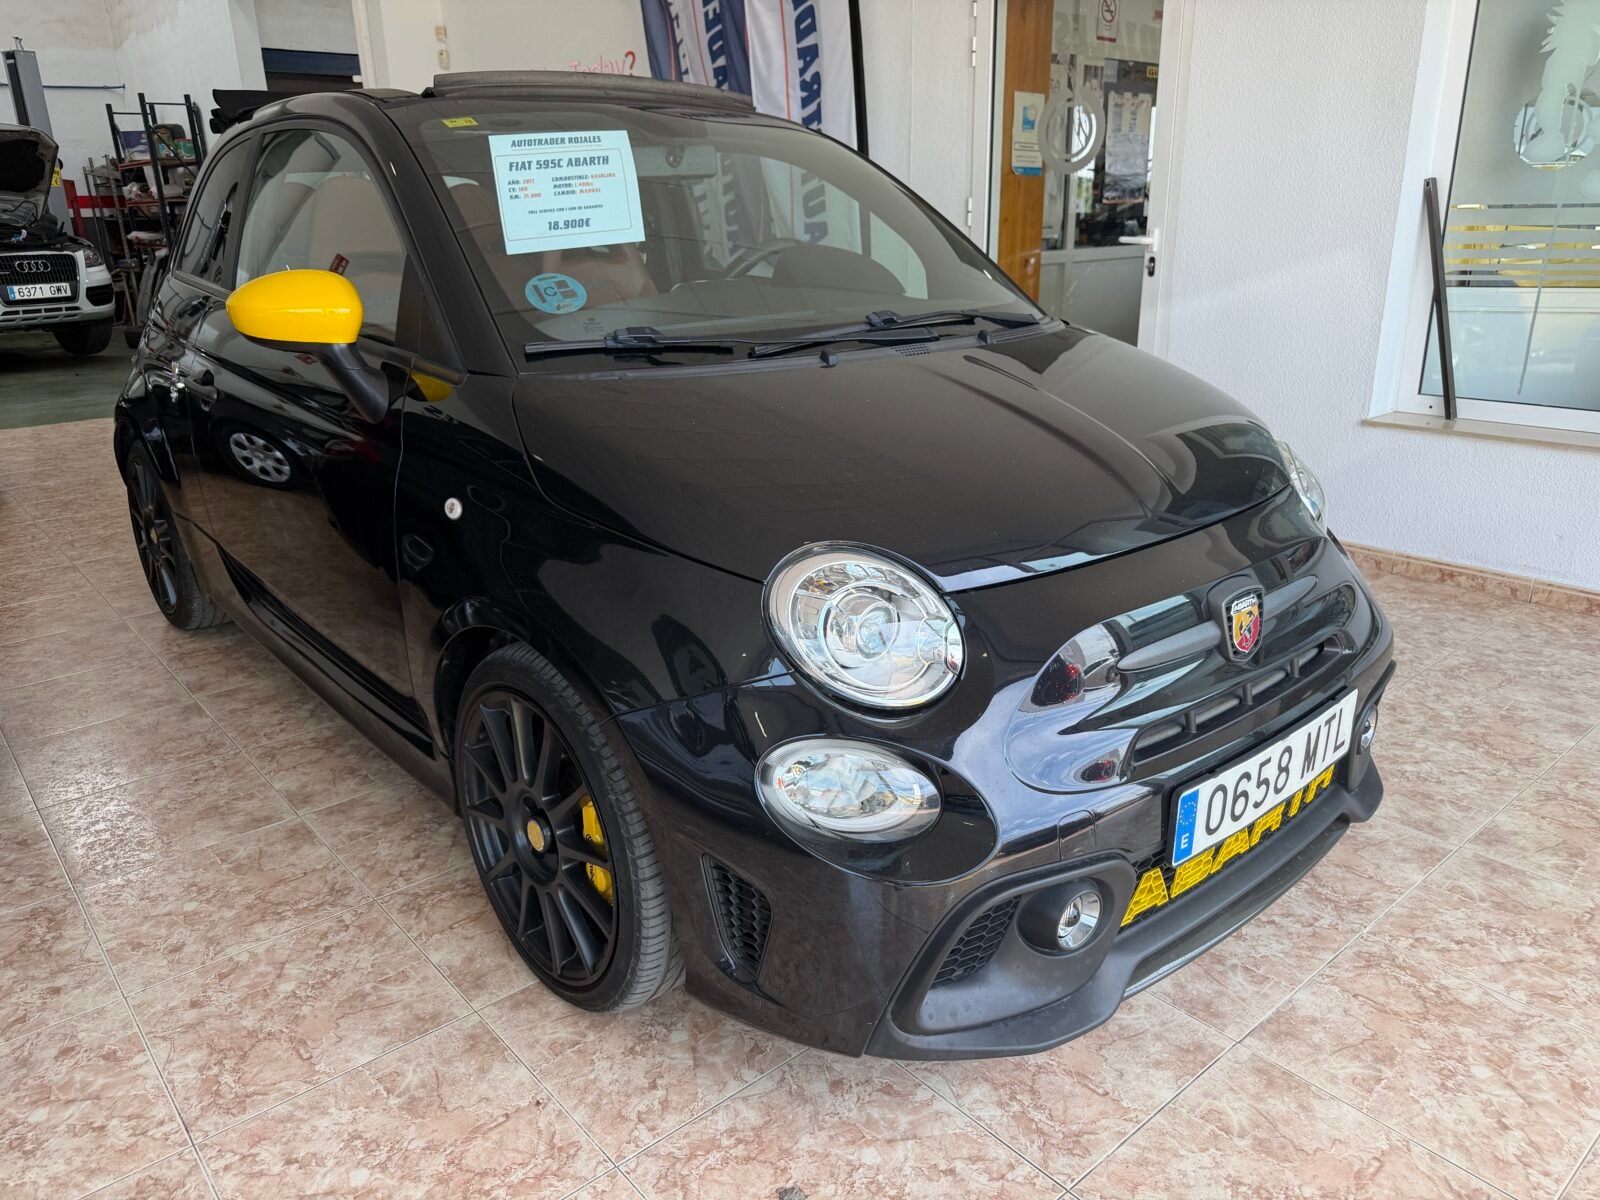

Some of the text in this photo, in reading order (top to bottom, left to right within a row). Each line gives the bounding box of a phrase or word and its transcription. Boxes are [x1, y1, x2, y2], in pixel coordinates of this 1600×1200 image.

[511, 135, 602, 148] AUTOTRADER ROJALES
[508, 155, 610, 172] FIAT 595C ABARTH
[547, 217, 592, 231] 18.900€
[18, 284, 68, 298] 6371 GWV
[1204, 707, 1346, 836] 0658 MTL
[1180, 832, 1190, 849] E
